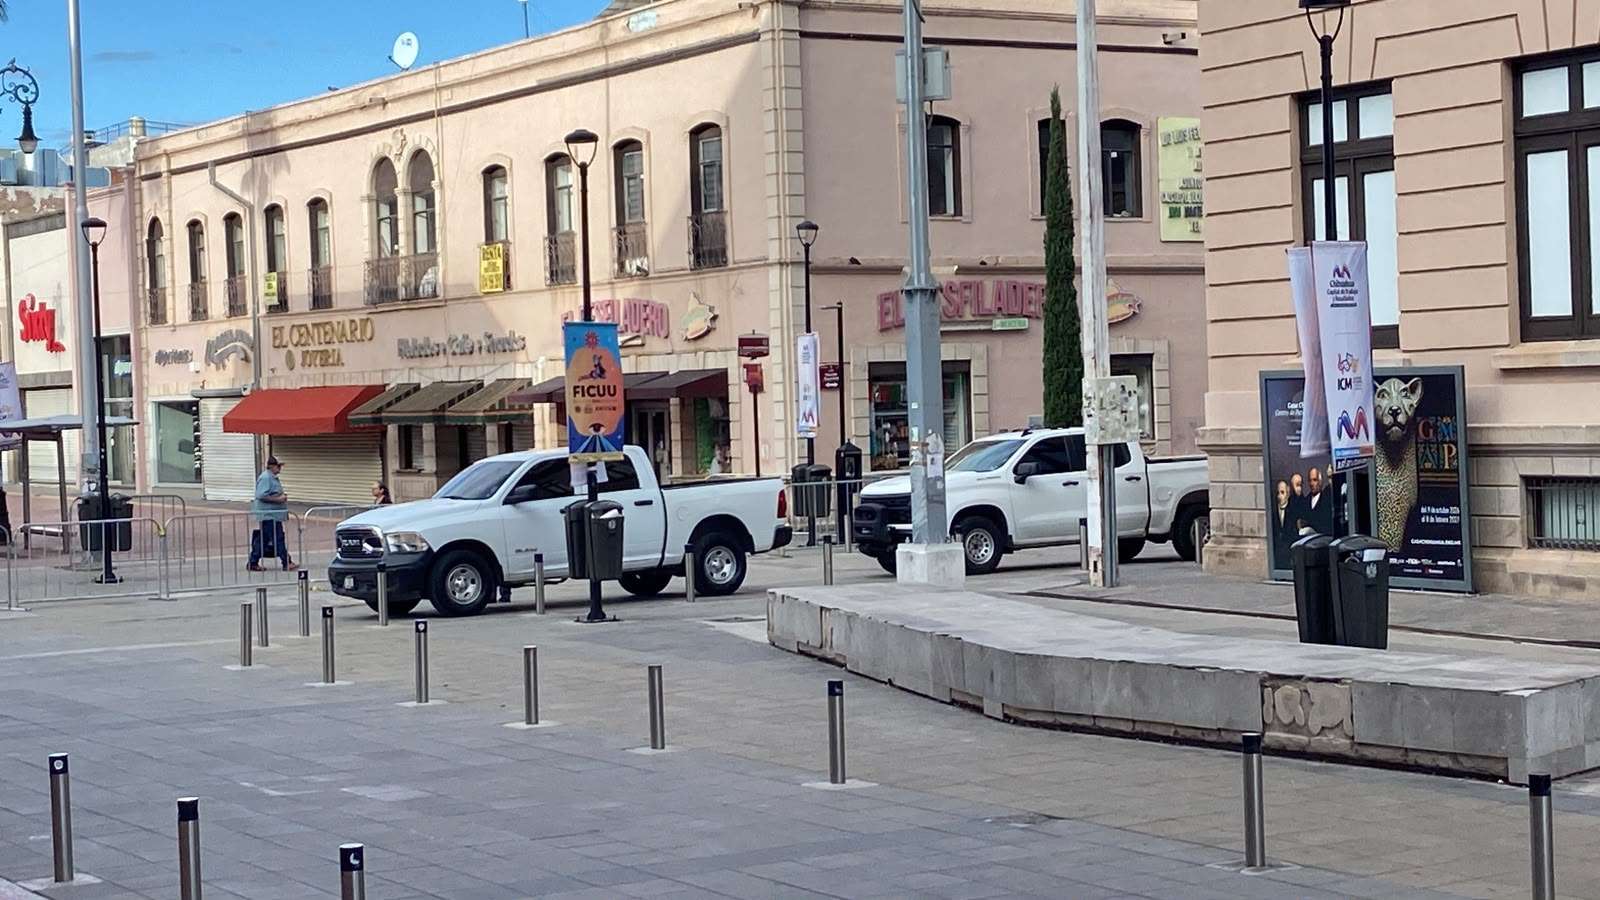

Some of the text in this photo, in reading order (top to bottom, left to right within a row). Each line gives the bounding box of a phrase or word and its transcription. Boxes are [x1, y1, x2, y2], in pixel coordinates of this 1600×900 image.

[272, 317, 375, 348] EL CENTENARIO
[573, 385, 617, 398] FICUU
